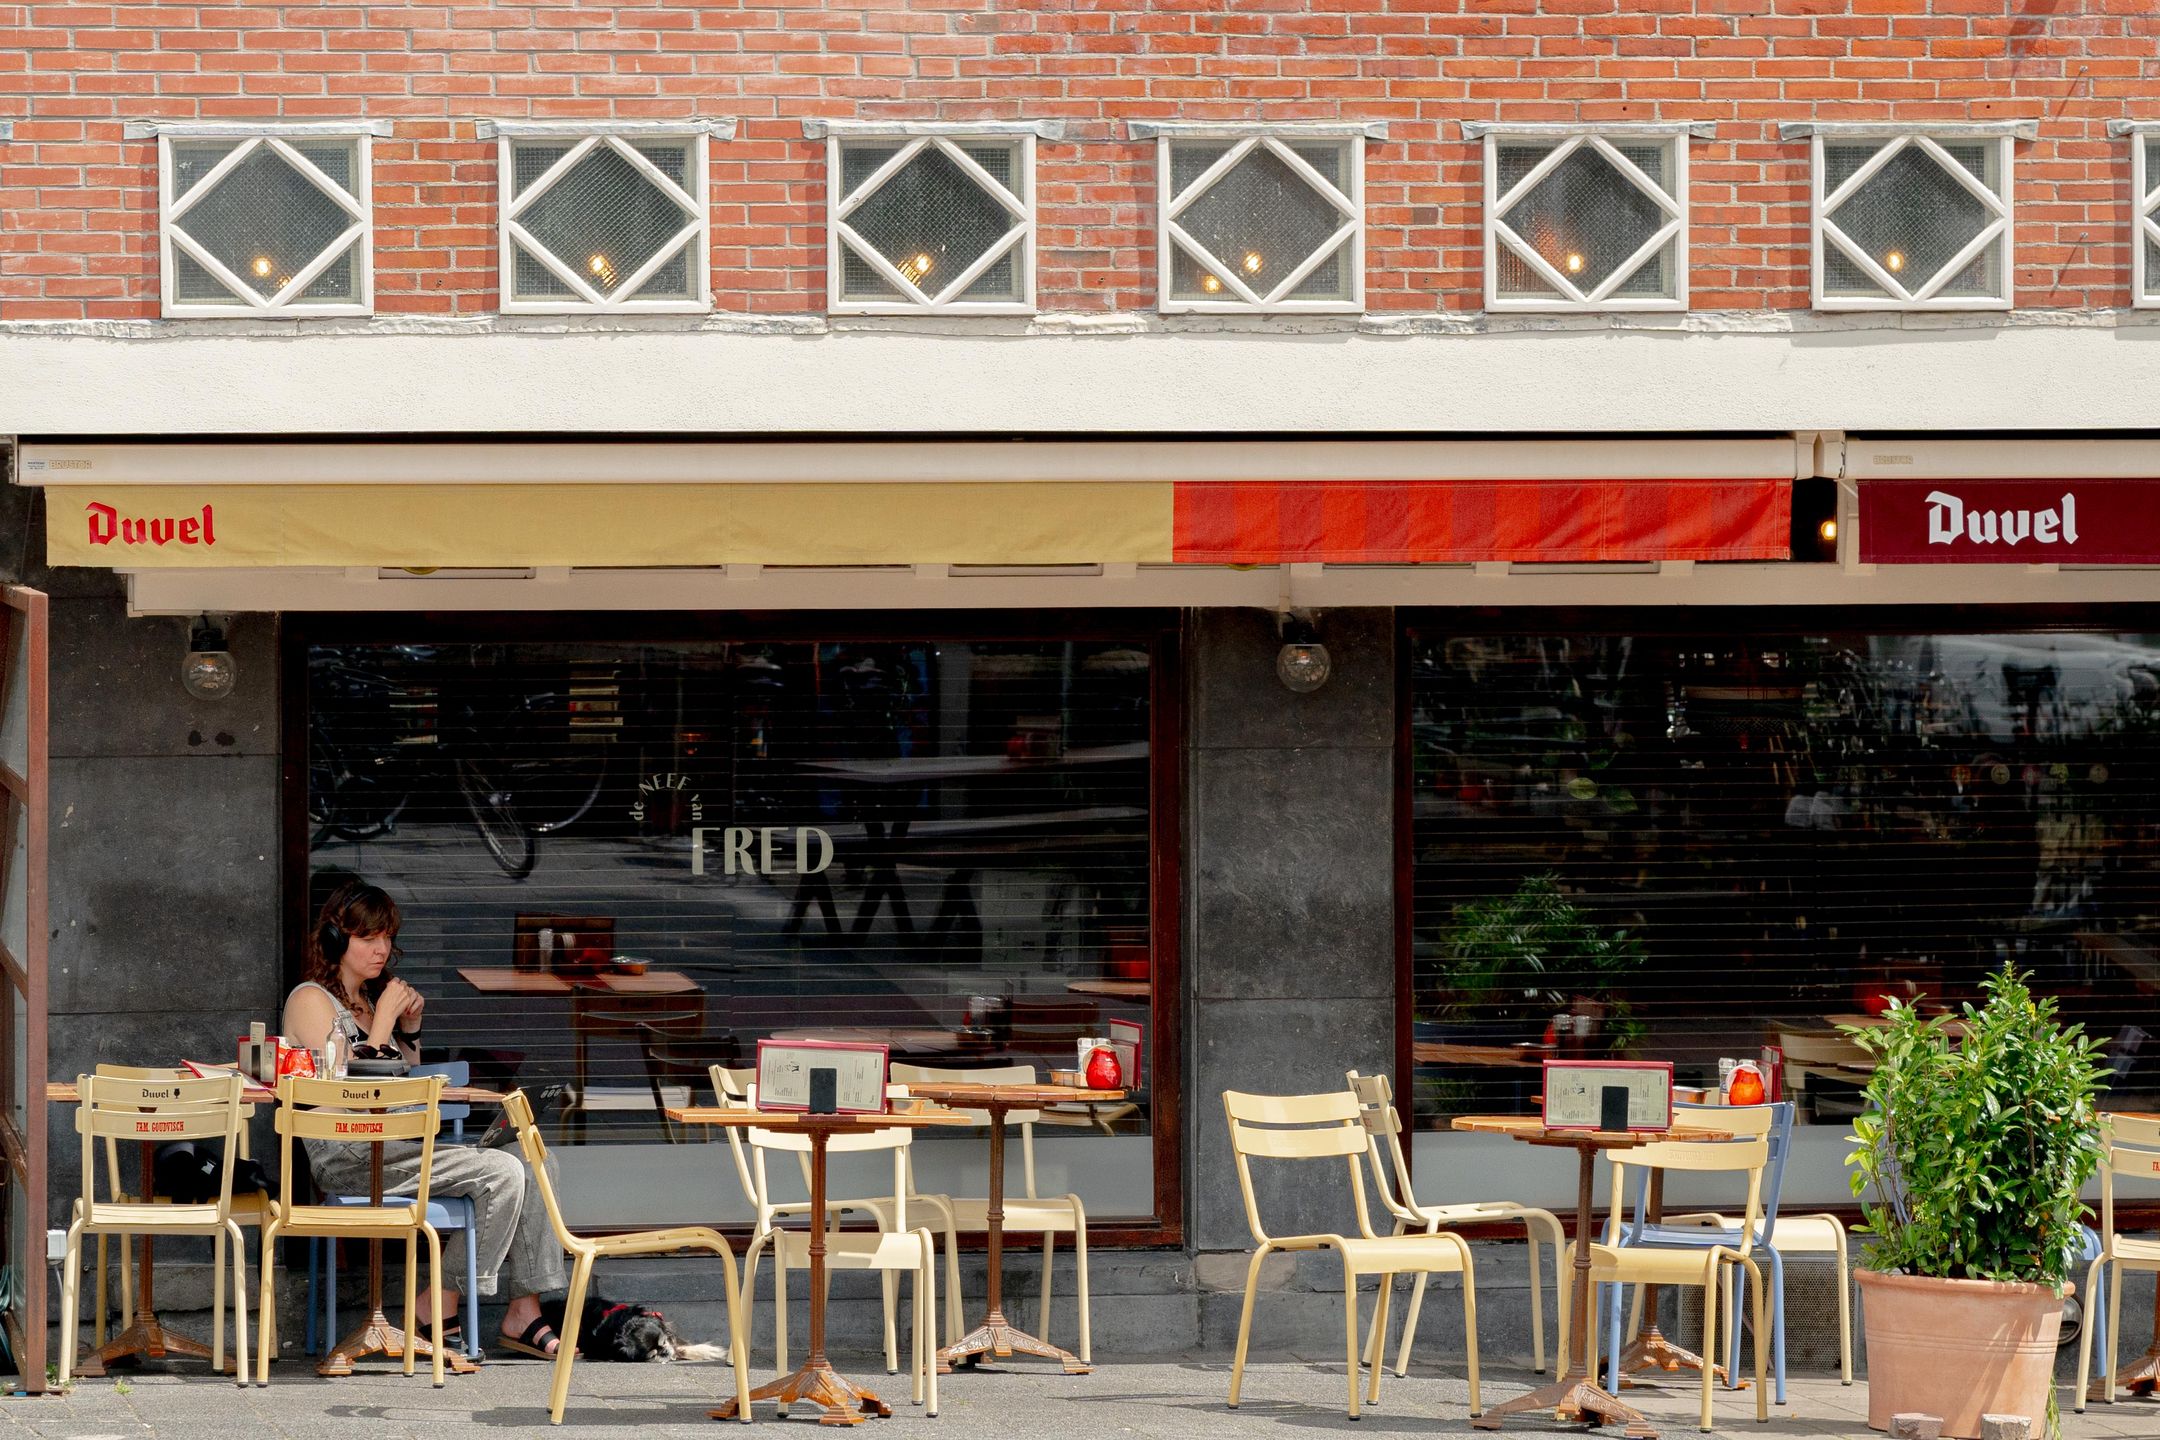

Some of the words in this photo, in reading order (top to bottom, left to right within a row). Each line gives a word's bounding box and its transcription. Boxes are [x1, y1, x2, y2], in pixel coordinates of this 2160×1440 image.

[86, 501, 215, 546] Duvel
[1924, 490, 2079, 546] Duvel
[628, 801, 644, 821] de
[638, 773, 691, 796] NEEF
[690, 794, 703, 821] van
[691, 827, 834, 875] FRED
[142, 1088, 169, 1099] Duvel
[342, 1088, 369, 1100] Duvel
[151, 1120, 185, 1133] GOUDVISCH
[350, 1122, 384, 1134] GOUDVISCH
